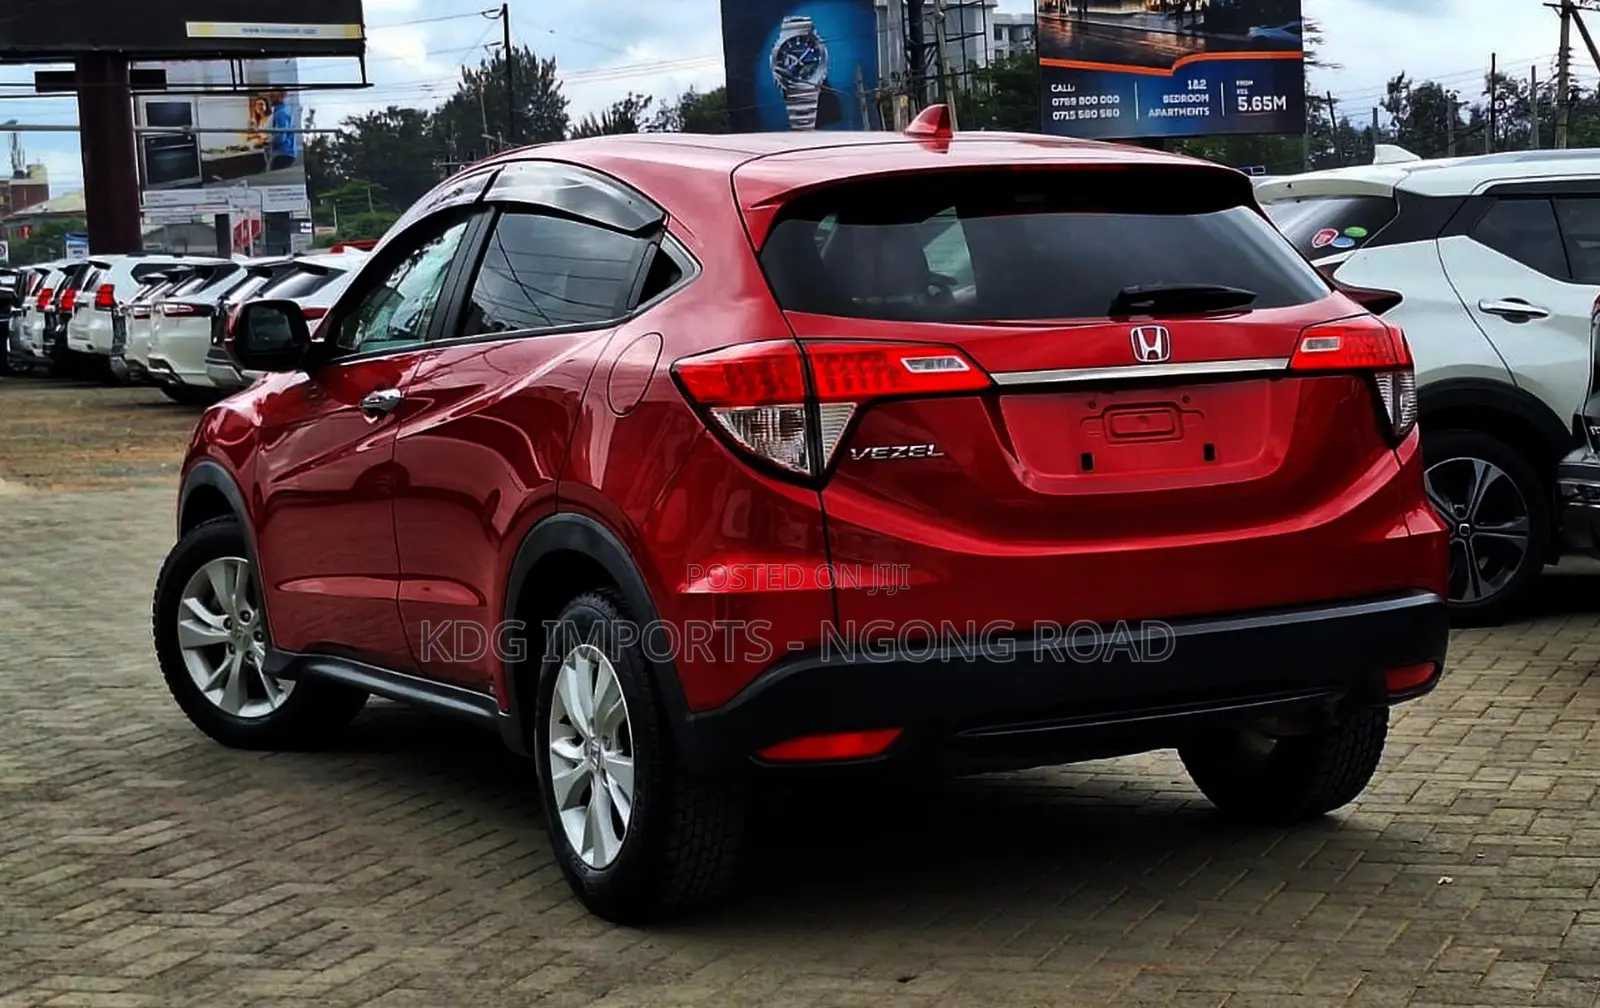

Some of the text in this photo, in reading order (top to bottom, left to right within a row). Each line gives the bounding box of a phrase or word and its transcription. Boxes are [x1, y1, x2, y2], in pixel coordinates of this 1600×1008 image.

[1163, 93, 1209, 103] BEDROOM
[1237, 95, 1287, 111] 5.65M
[1148, 107, 1210, 117] APARTMENTS
[850, 444, 945, 461] VEZEL
